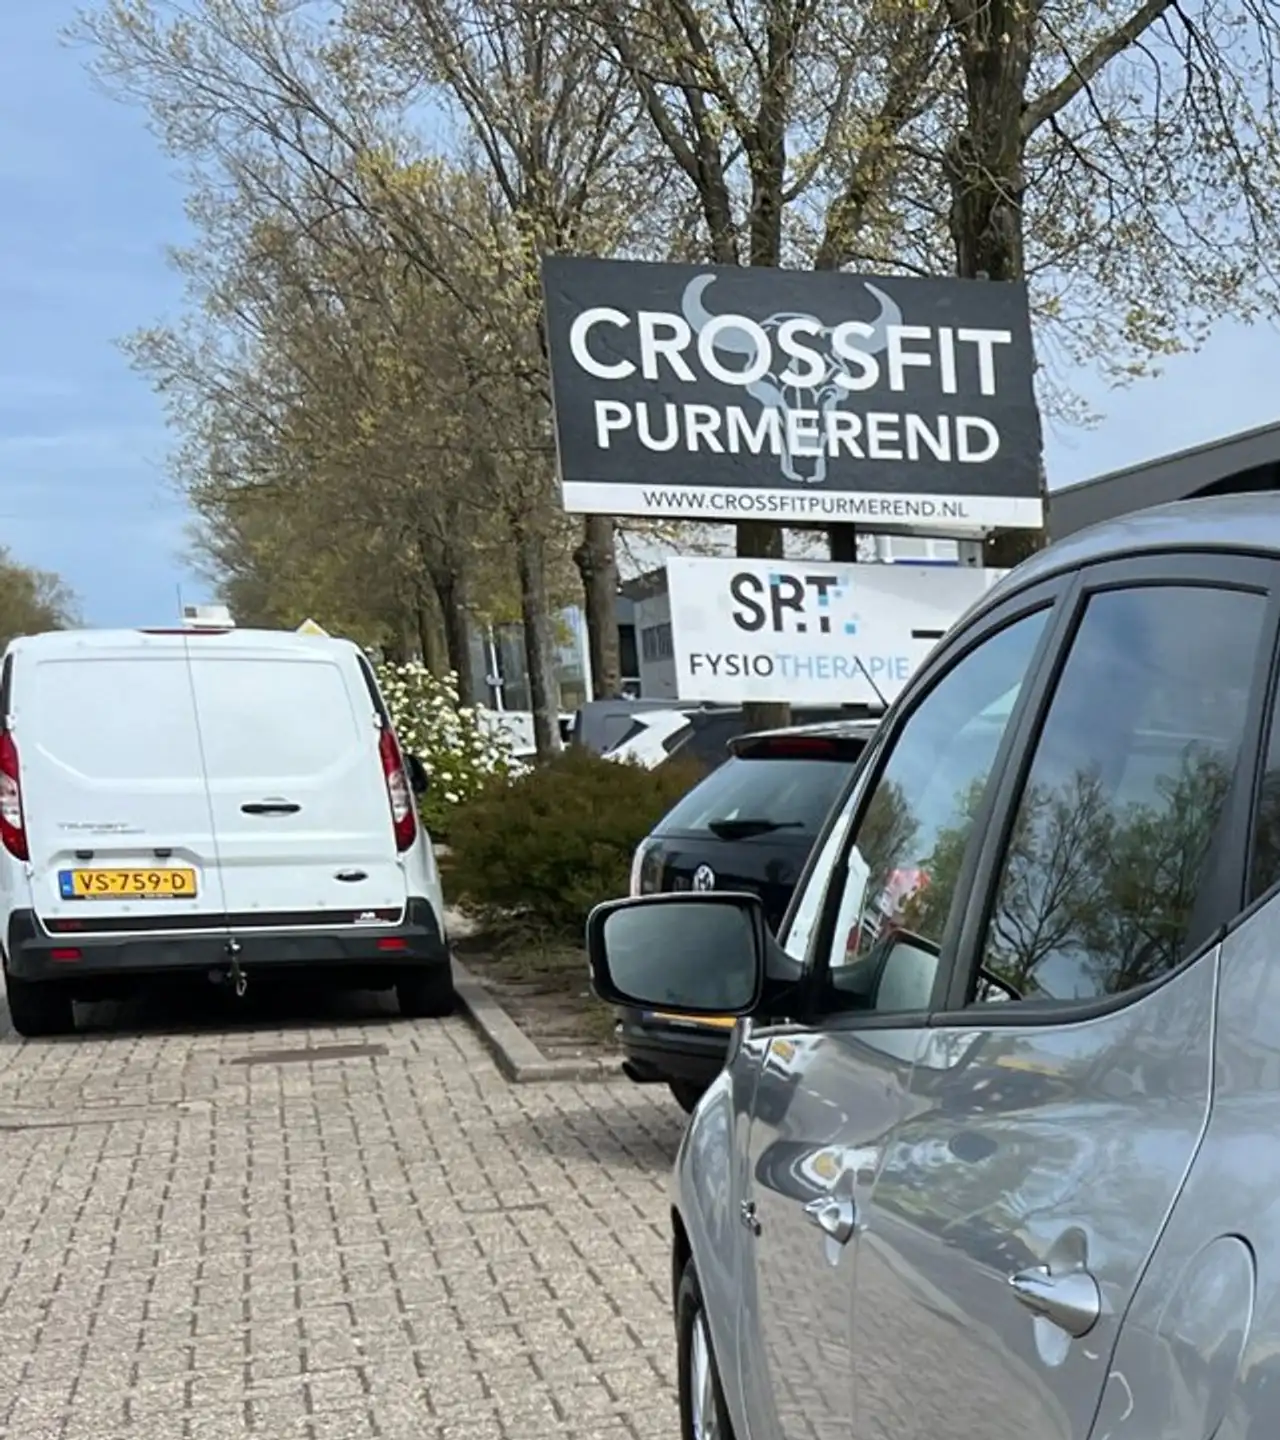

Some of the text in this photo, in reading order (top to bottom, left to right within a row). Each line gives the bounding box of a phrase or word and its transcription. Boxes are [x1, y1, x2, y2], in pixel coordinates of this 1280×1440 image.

[569, 307, 1011, 396] CROSSFIT
[594, 400, 1000, 463] PURMEREND
[643, 490, 969, 519] WWW.CROSSFITPURMEREND.NL
[689, 653, 910, 681] FYSIOTHERAPIE
[80, 873, 185, 892] VS-759-D
